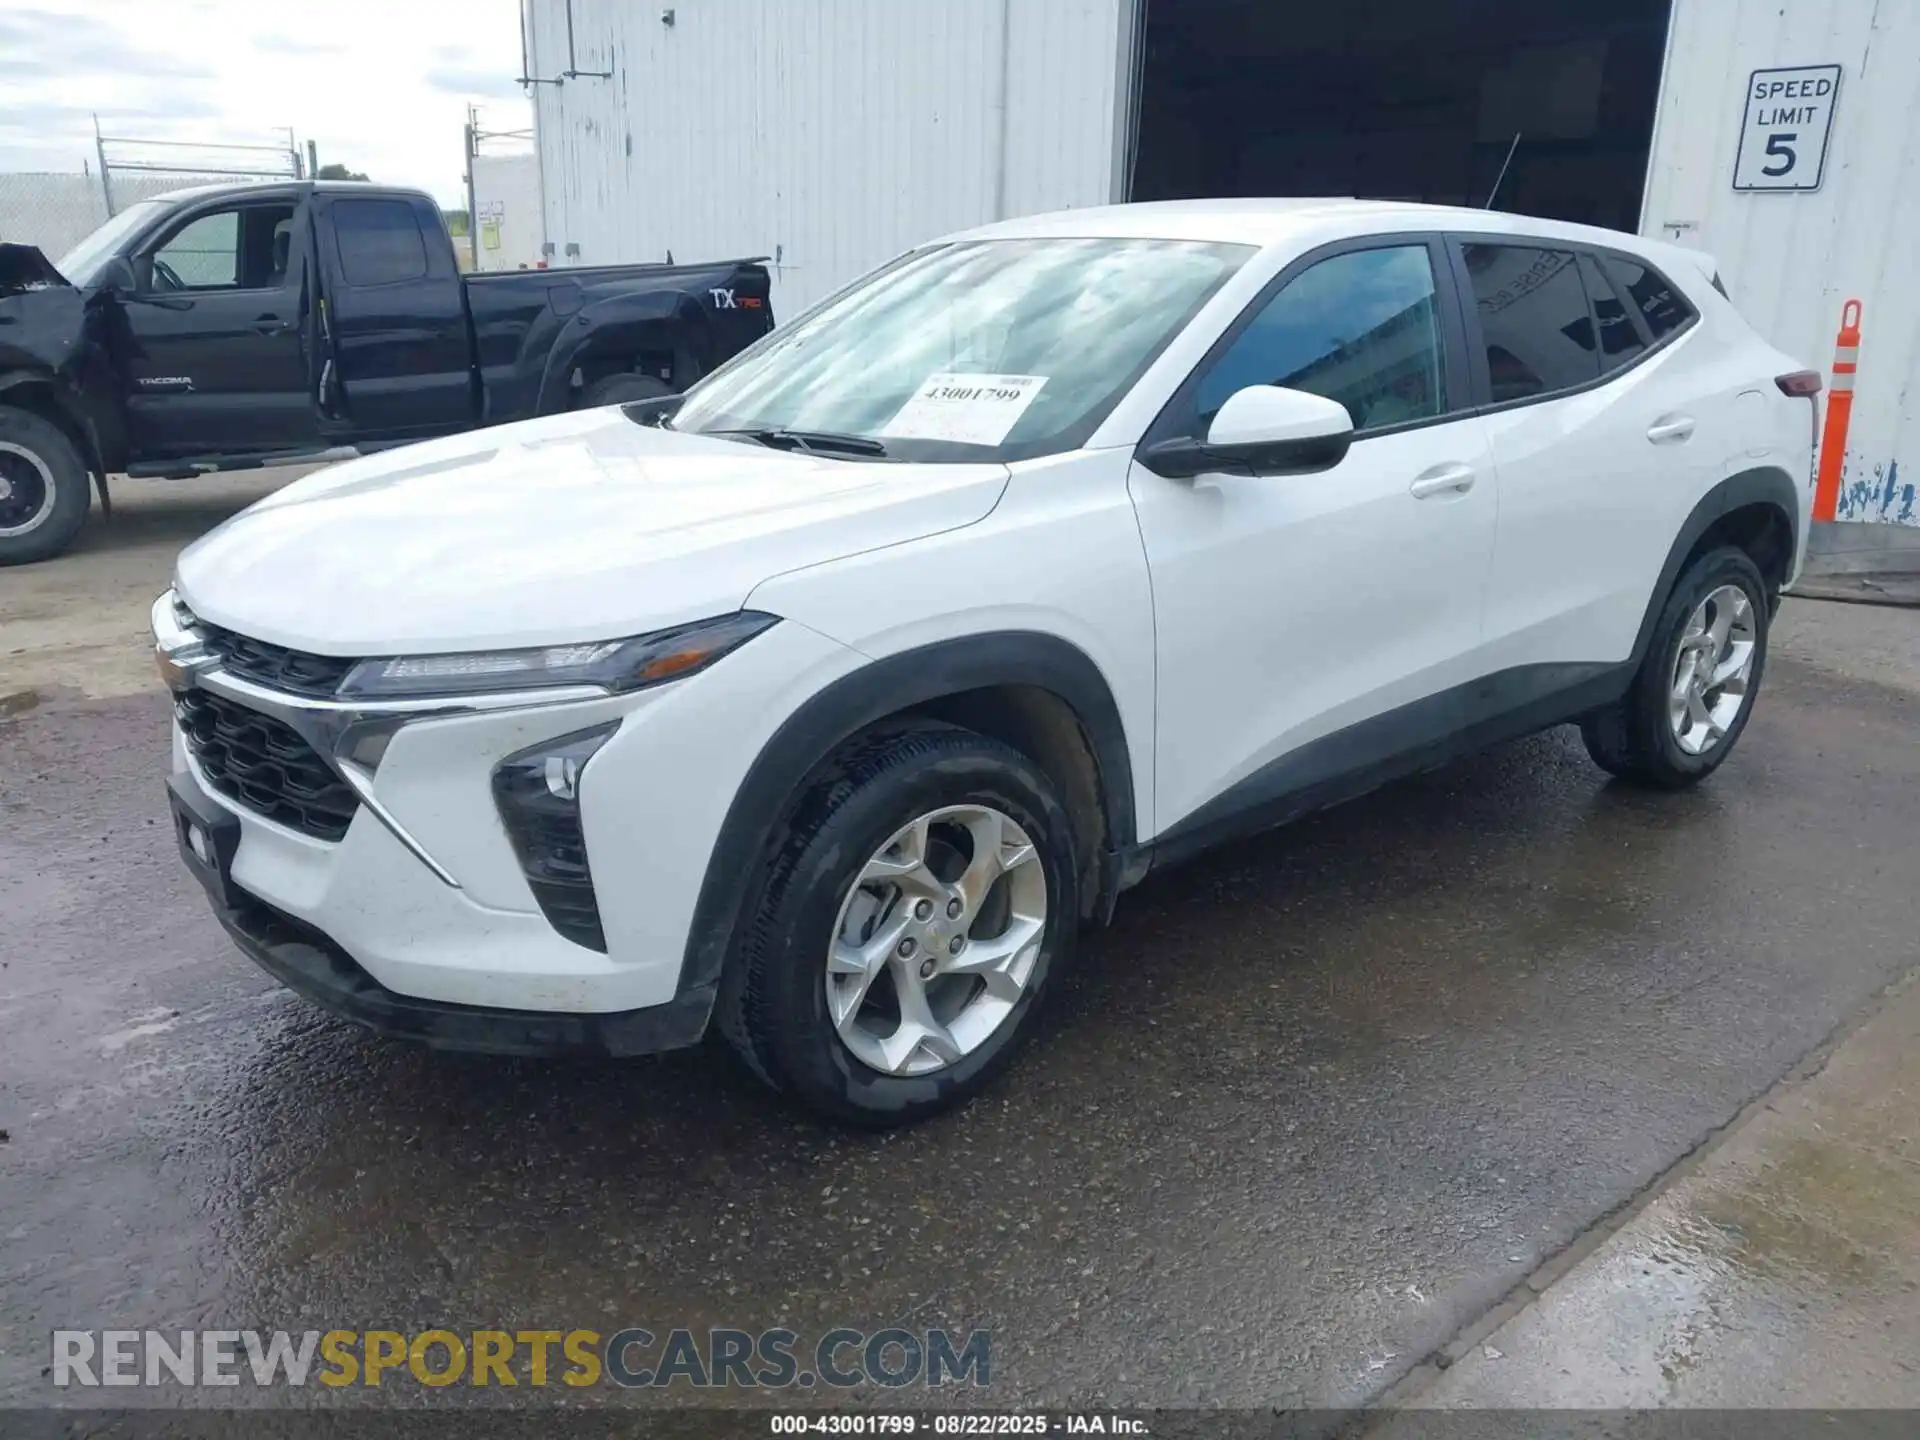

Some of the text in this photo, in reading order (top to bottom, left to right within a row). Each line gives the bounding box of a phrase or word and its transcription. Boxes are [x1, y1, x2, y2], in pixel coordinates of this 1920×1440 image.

[1754, 78, 1832, 100] SPEED
[1757, 106, 1818, 126] LIMIT
[1761, 132, 1798, 177] 5
[708, 287, 737, 309] TX
[925, 386, 1022, 401] 43001799
